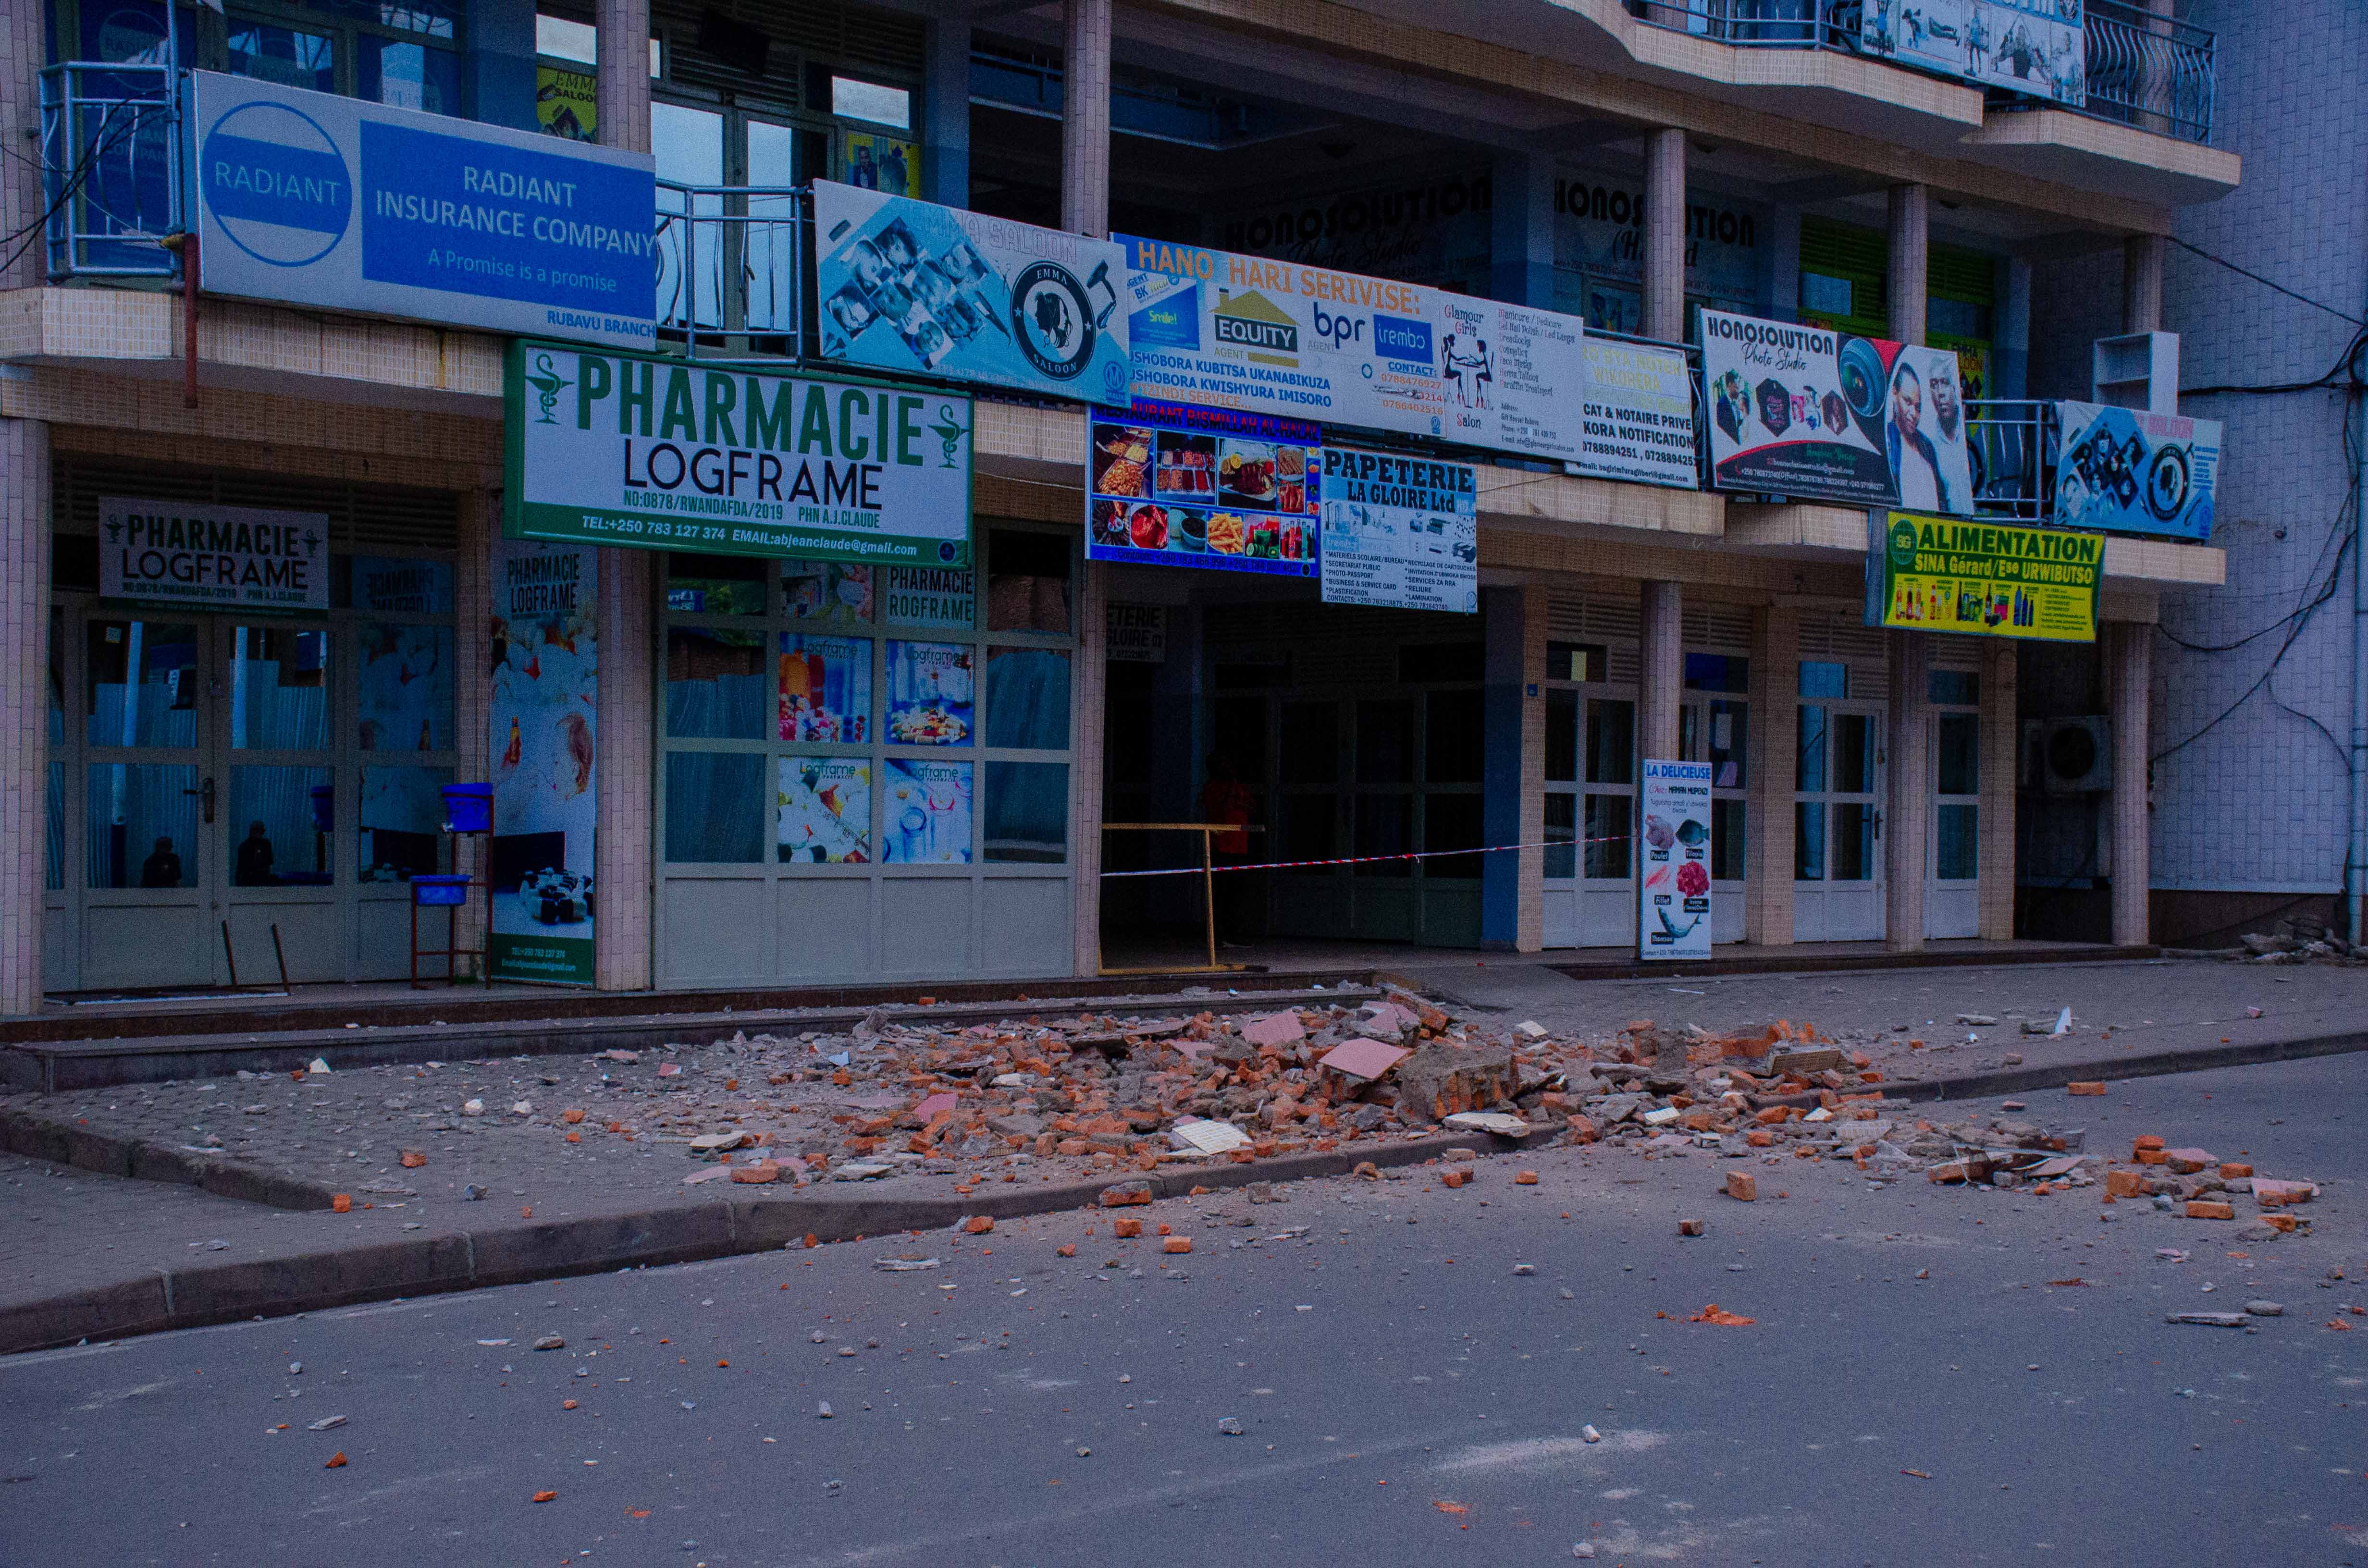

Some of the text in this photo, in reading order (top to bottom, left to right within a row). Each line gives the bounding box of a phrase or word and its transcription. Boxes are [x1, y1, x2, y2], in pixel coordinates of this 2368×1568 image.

[555, 88, 597, 103] SALOO
[214, 161, 341, 206] RADIANT
[464, 166, 577, 208] RADIANT
[376, 190, 656, 258] INSURANCE COMPANY
[988, 219, 1077, 264] SALOON
[428, 248, 617, 293] A Promise is a promise
[1036, 268, 1068, 285] EMMA
[1127, 272, 1148, 287] GENT
[1138, 241, 1214, 280] HANO
[1229, 257, 1293, 293] HARI
[1300, 269, 1420, 315] SERIVISE:
[1135, 285, 1148, 299] BK
[547, 310, 657, 338] RUBAVU BRANCH
[1313, 302, 1366, 349] bpr
[1444, 304, 1484, 324] Glamour
[1499, 308, 1529, 323] Manicure
[1219, 319, 1293, 347] EQUITY
[1455, 321, 1477, 337] Girls
[1707, 317, 1833, 355] HONOSOLUTION
[1214, 347, 1244, 360] AGENT
[1307, 340, 1335, 352] AGENT
[1741, 343, 1807, 371] Photo Studio
[1033, 354, 1077, 373] SALOON
[1196, 358, 1246, 378] KUBITSA
[1250, 367, 1331, 391] UKANABIKUZA
[1388, 361, 1437, 377] CONTACT:
[1202, 378, 1275, 400] KWISHYURA
[1279, 389, 1332, 407] IMISORO
[577, 355, 925, 466] PHARMACIE
[1456, 413, 1482, 429] Salon
[1583, 404, 1691, 430] CAT & NOTAIRE PRIVE
[1583, 421, 1694, 449] KORA NOTIFICATION
[1582, 441, 1638, 459] 0788894251
[623, 438, 882, 510] LOGFRAME
[1323, 449, 1472, 493] PAPETERIE
[623, 490, 880, 529] NO:0878/RWANDAFDA/2019 PHN A.J.CLAUDE
[1347, 481, 1455, 513] LA GLOIRE Ltd
[127, 514, 299, 557] PHARMACIE
[582, 515, 643, 533] TEL:+250
[646, 520, 672, 535] 783
[675, 523, 700, 538] 127
[702, 526, 726, 541] 374
[1329, 551, 1356, 560] MATERIELS
[1919, 524, 2096, 562] ALIMENTATION
[123, 549, 308, 589] LOGFRAME
[507, 553, 580, 586] PHARMACIE
[1329, 560, 1381, 571] SECRETARIAT PUBLIC
[1329, 569, 1373, 579] PHOTO-PASSPORT
[1914, 553, 1946, 574] SINA
[2022, 561, 2094, 585] URWIBUTSO
[889, 567, 973, 594] PHARMACIE
[1329, 578, 1355, 587] BUSINESS
[1329, 587, 1369, 596] PLASTIFICATION
[1408, 576, 1435, 585] SERVICES
[511, 582, 577, 613] LOGFRAME
[889, 595, 973, 622] ROGFRAME
[1408, 594, 1442, 602] LAMINATION
[802, 640, 858, 656] Logframe
[800, 761, 856, 775] Logframe
[1647, 764, 1710, 779] LA DELICIEUSE
[1651, 852, 1668, 860] Poulet
